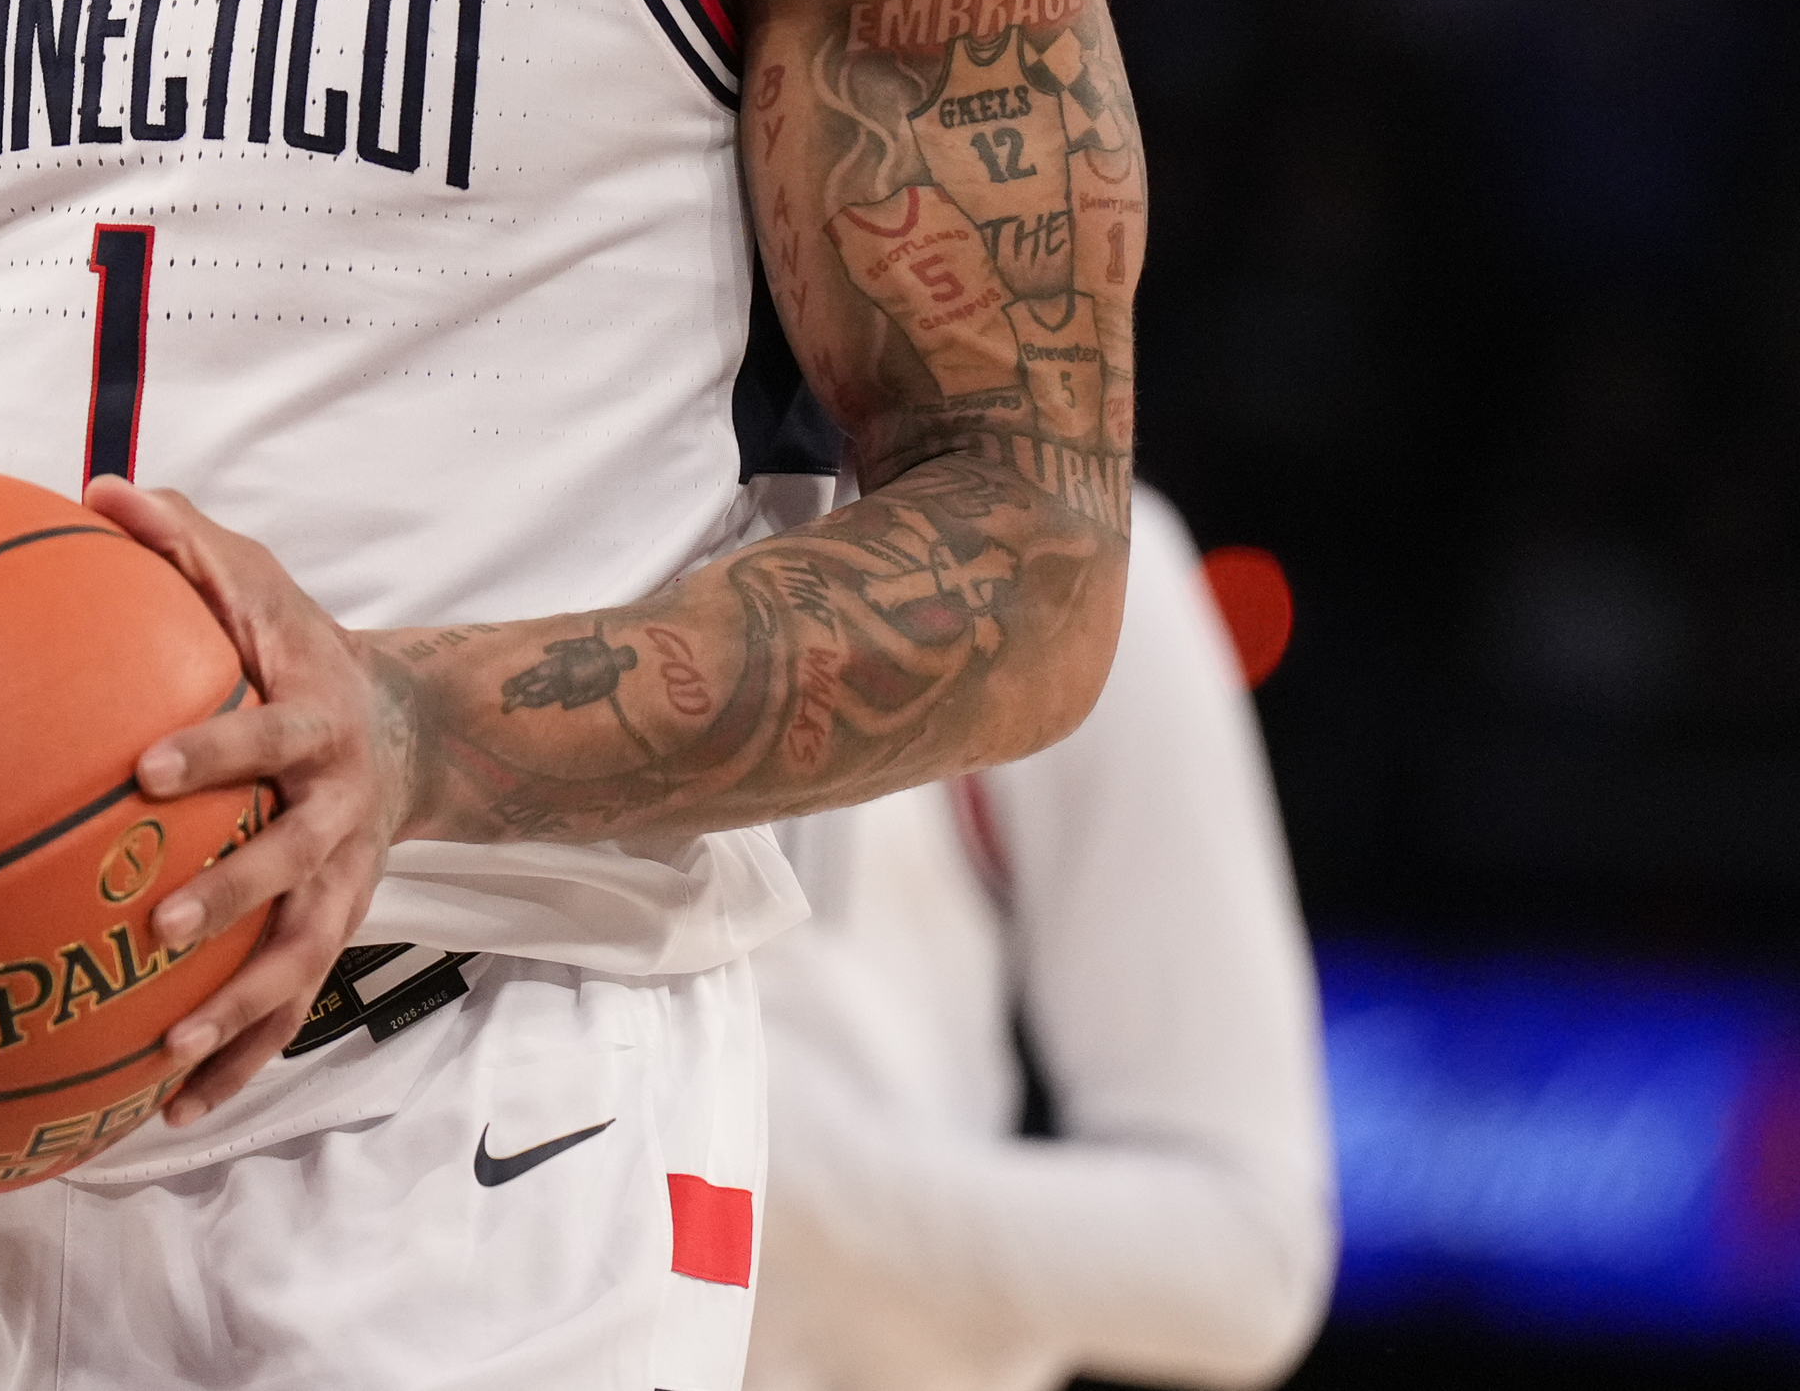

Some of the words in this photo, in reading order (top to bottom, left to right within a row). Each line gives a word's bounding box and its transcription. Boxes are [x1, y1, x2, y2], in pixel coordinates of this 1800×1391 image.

[969, 127, 1038, 184] 12
[865, 229, 970, 282] SCOTLAND
[977, 209, 1071, 266] THE
[1104, 222, 1126, 286] 1
[909, 254, 965, 303] 5
[919, 287, 1003, 332] CAMPUS
[82, 222, 155, 505] 1
[1022, 343, 1100, 363] Brewster
[1059, 370, 1077, 410] 5
[644, 626, 711, 716] GOD
